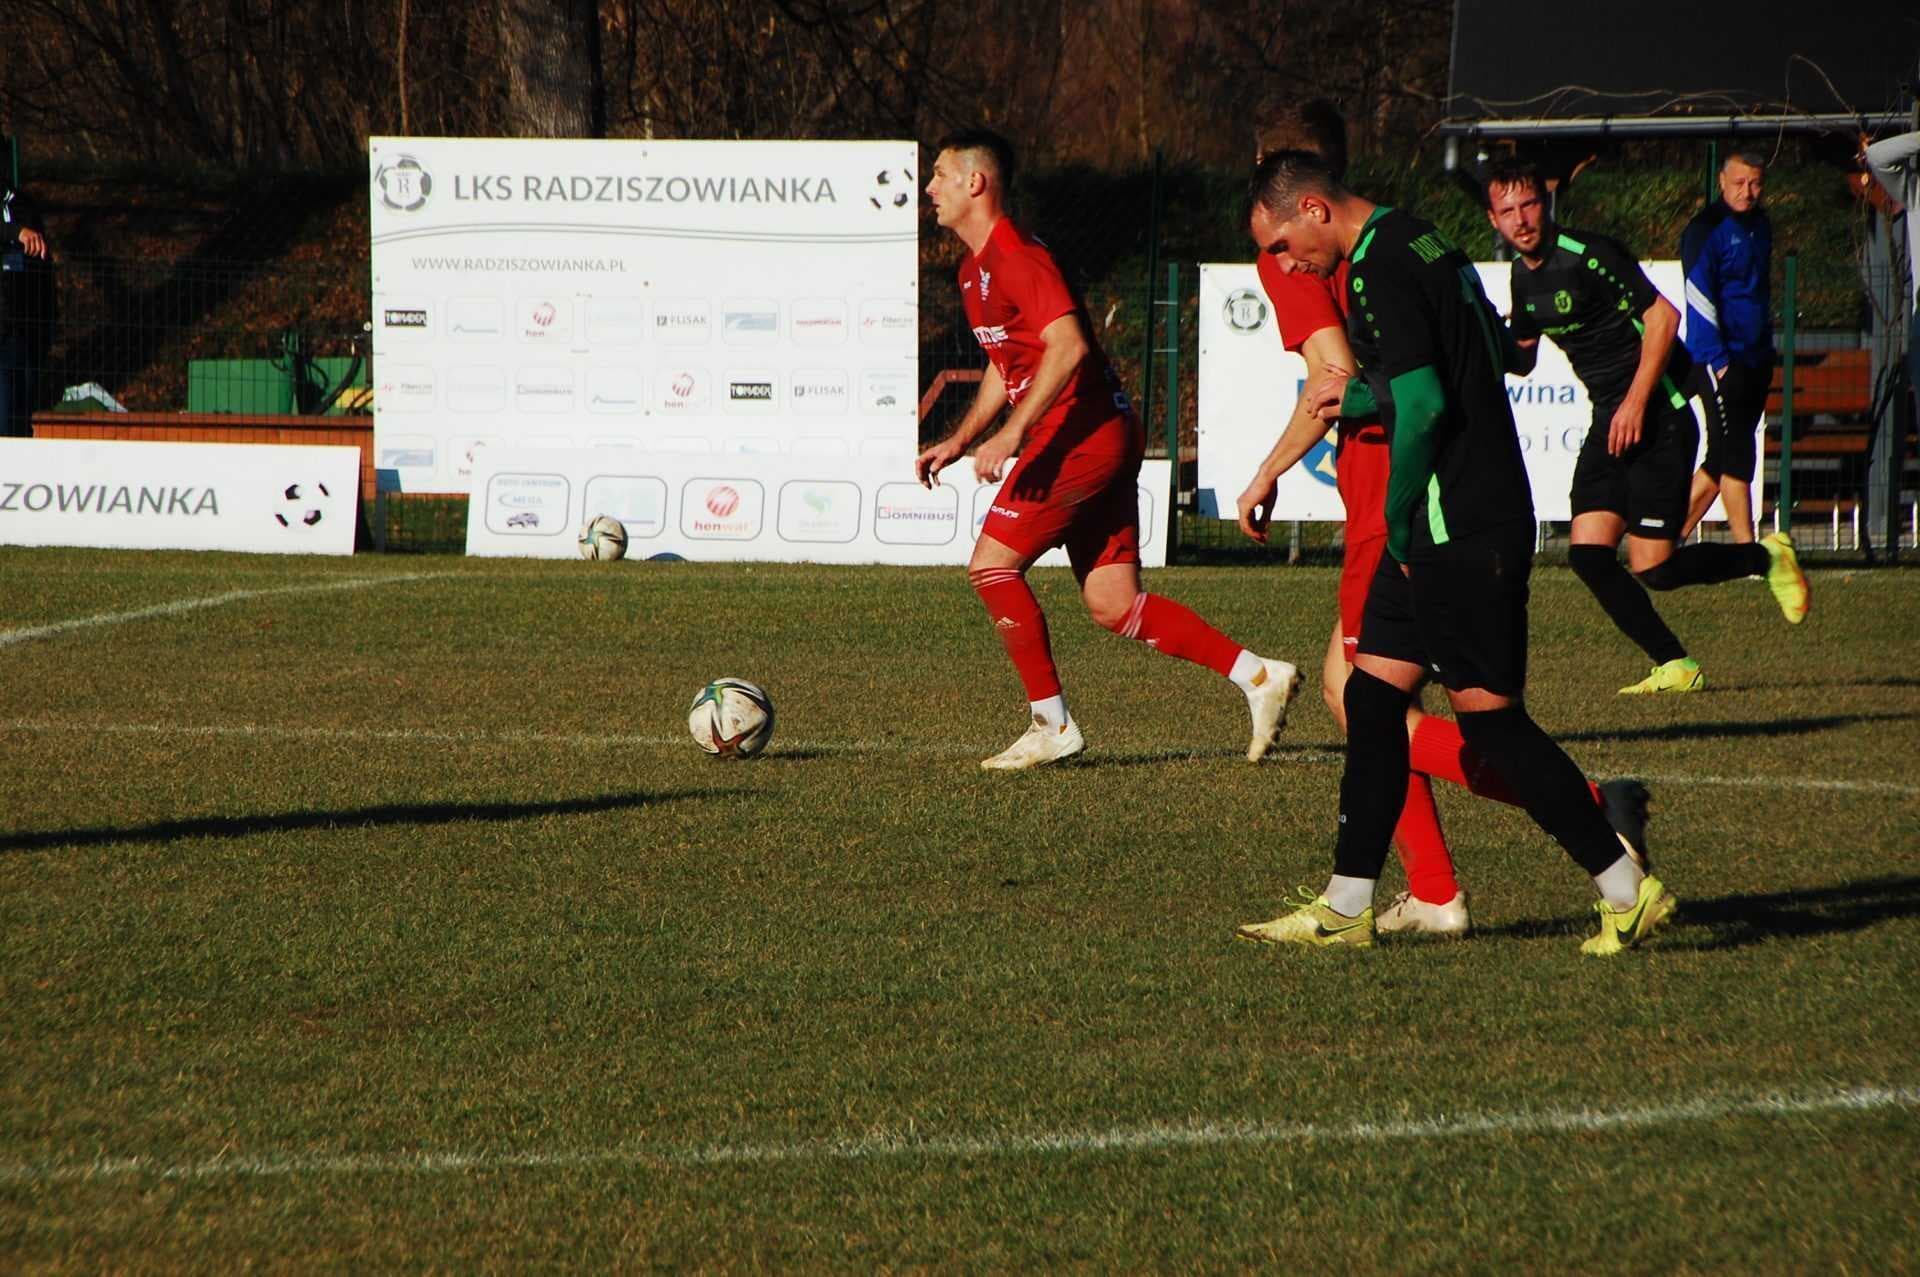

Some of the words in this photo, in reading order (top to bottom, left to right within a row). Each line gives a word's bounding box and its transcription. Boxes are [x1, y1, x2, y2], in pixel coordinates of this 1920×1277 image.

[454, 174, 512, 201] LKS
[523, 175, 837, 203] RADZISZOWIANKA
[411, 257, 627, 273] WWW.RADZISZOWIANKA.PL
[0, 483, 219, 515] ZOWIANKA
